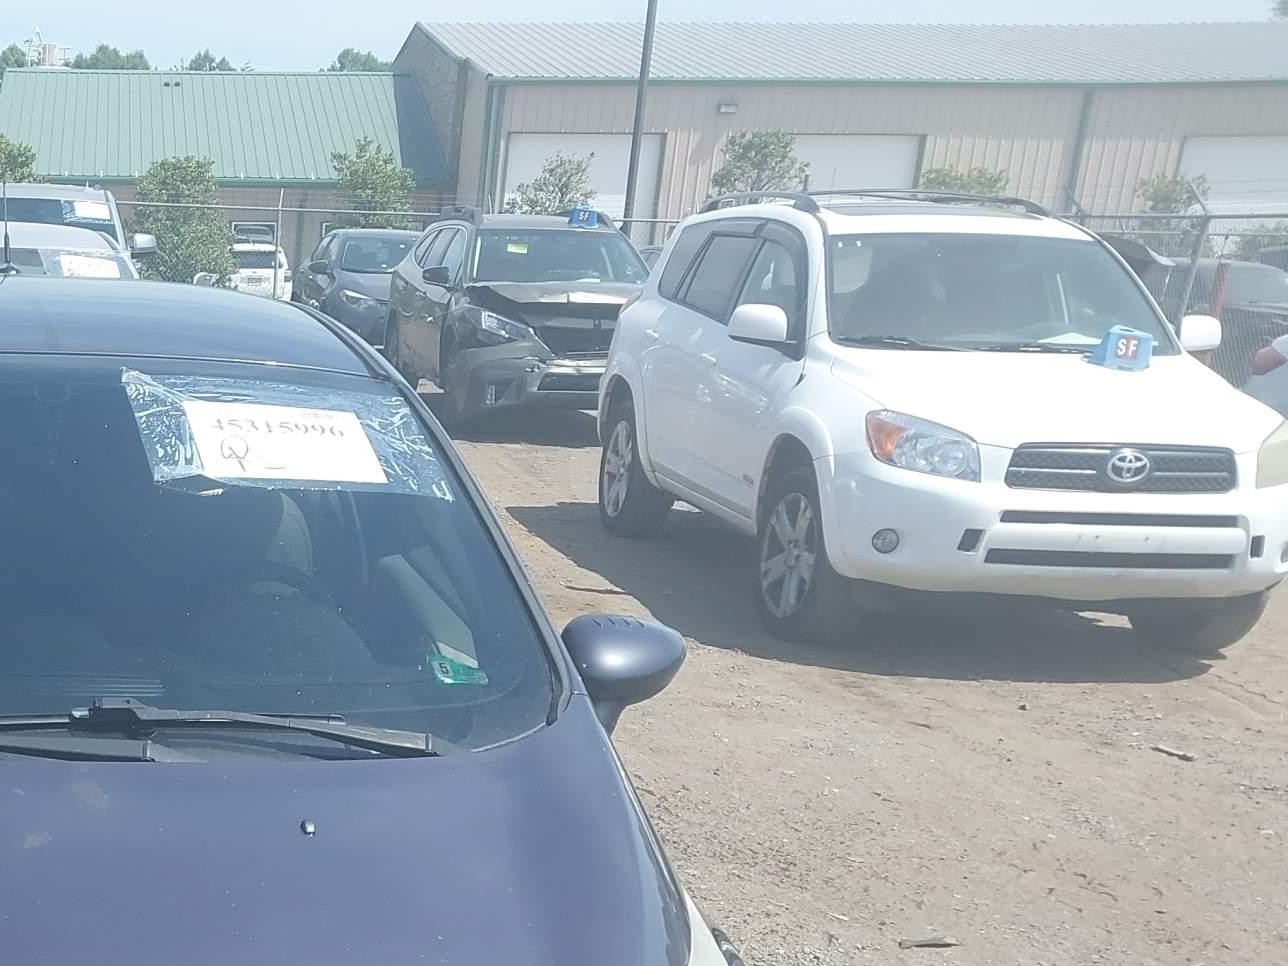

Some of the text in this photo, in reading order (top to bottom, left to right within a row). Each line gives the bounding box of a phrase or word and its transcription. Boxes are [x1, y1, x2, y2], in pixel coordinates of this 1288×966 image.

[578, 211, 590, 221] SF
[1117, 338, 1139, 356] SF
[438, 662, 450, 675] 5
